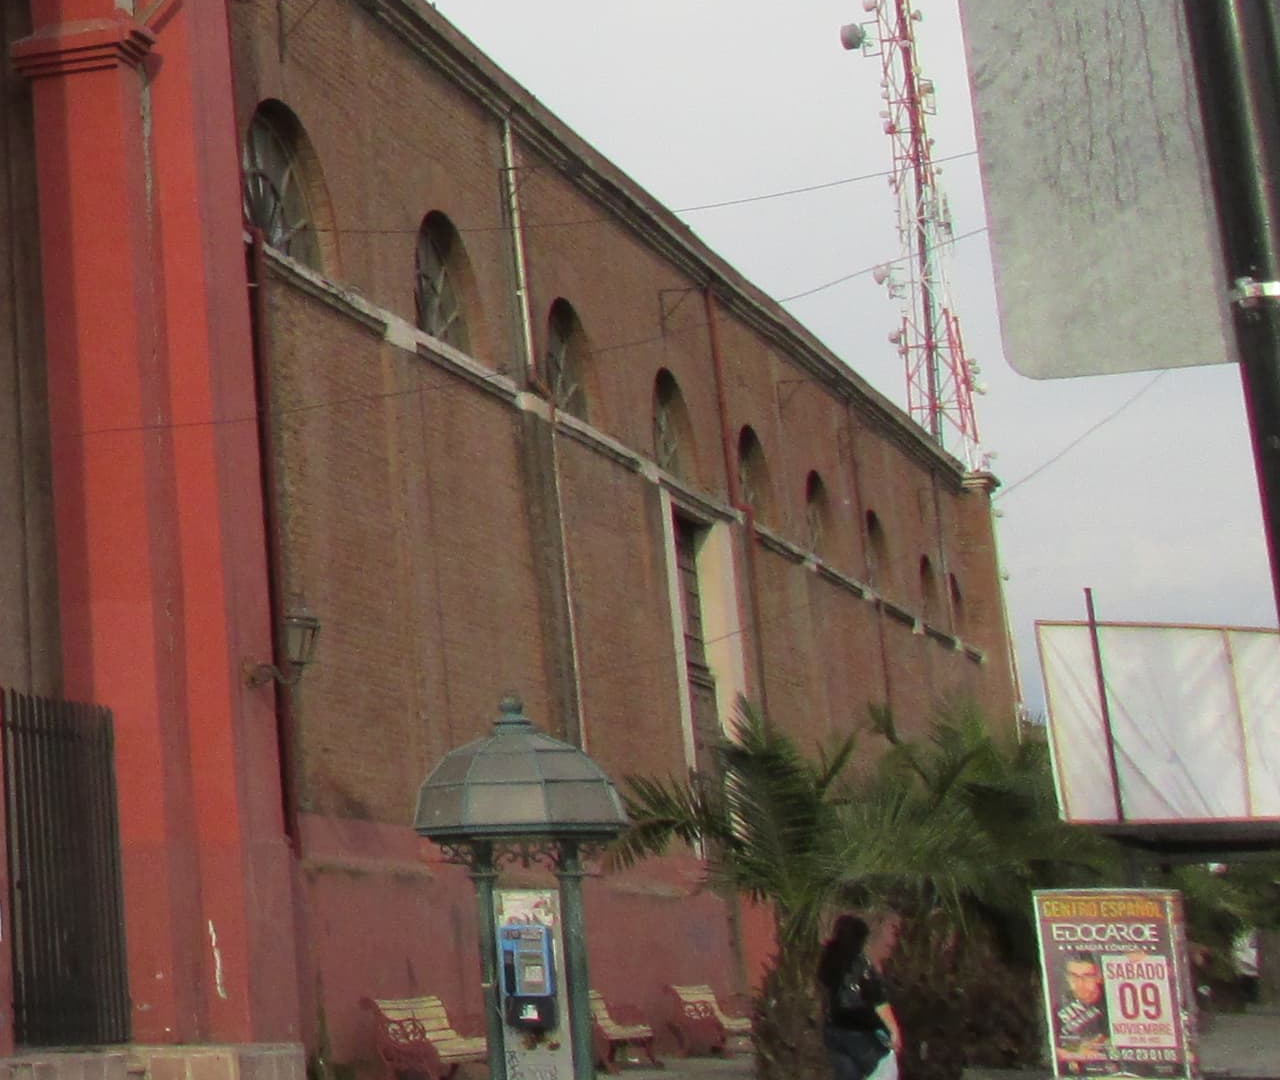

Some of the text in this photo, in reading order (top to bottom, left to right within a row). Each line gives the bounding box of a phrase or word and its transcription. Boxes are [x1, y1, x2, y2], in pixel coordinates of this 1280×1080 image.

[1043, 901, 1097, 918] CENTRO
[1052, 923, 1160, 942] EDOCAROE
[1106, 962, 1166, 980] SABADO
[1118, 982, 1162, 1020] 09
[1112, 1022, 1174, 1036] NOVIEMBRE
